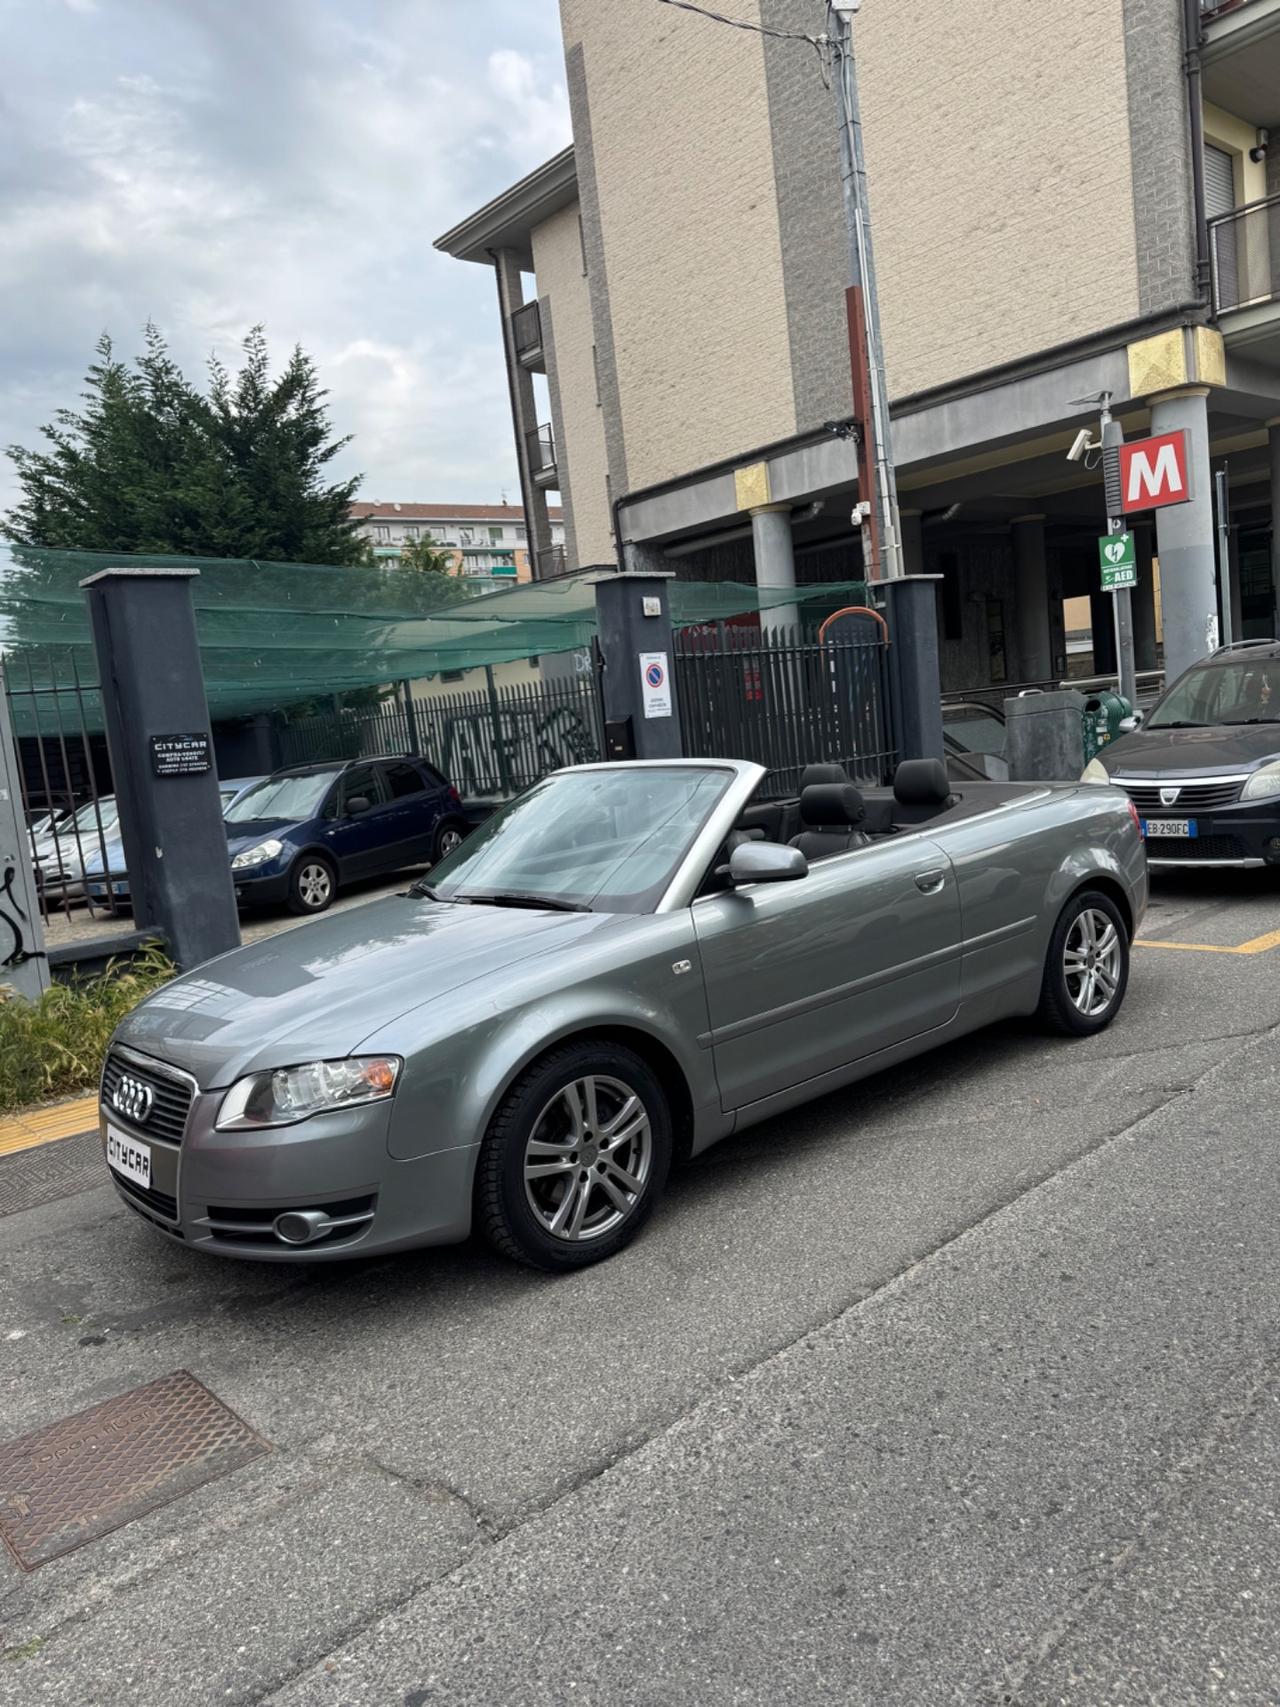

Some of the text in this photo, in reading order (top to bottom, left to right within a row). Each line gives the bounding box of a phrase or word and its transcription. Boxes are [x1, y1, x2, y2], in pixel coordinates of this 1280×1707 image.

[1127, 443, 1183, 502] M
[1114, 570, 1133, 583] AED
[154, 741, 207, 751] CITYCAR
[109, 1135, 149, 1178] CITYCAR
